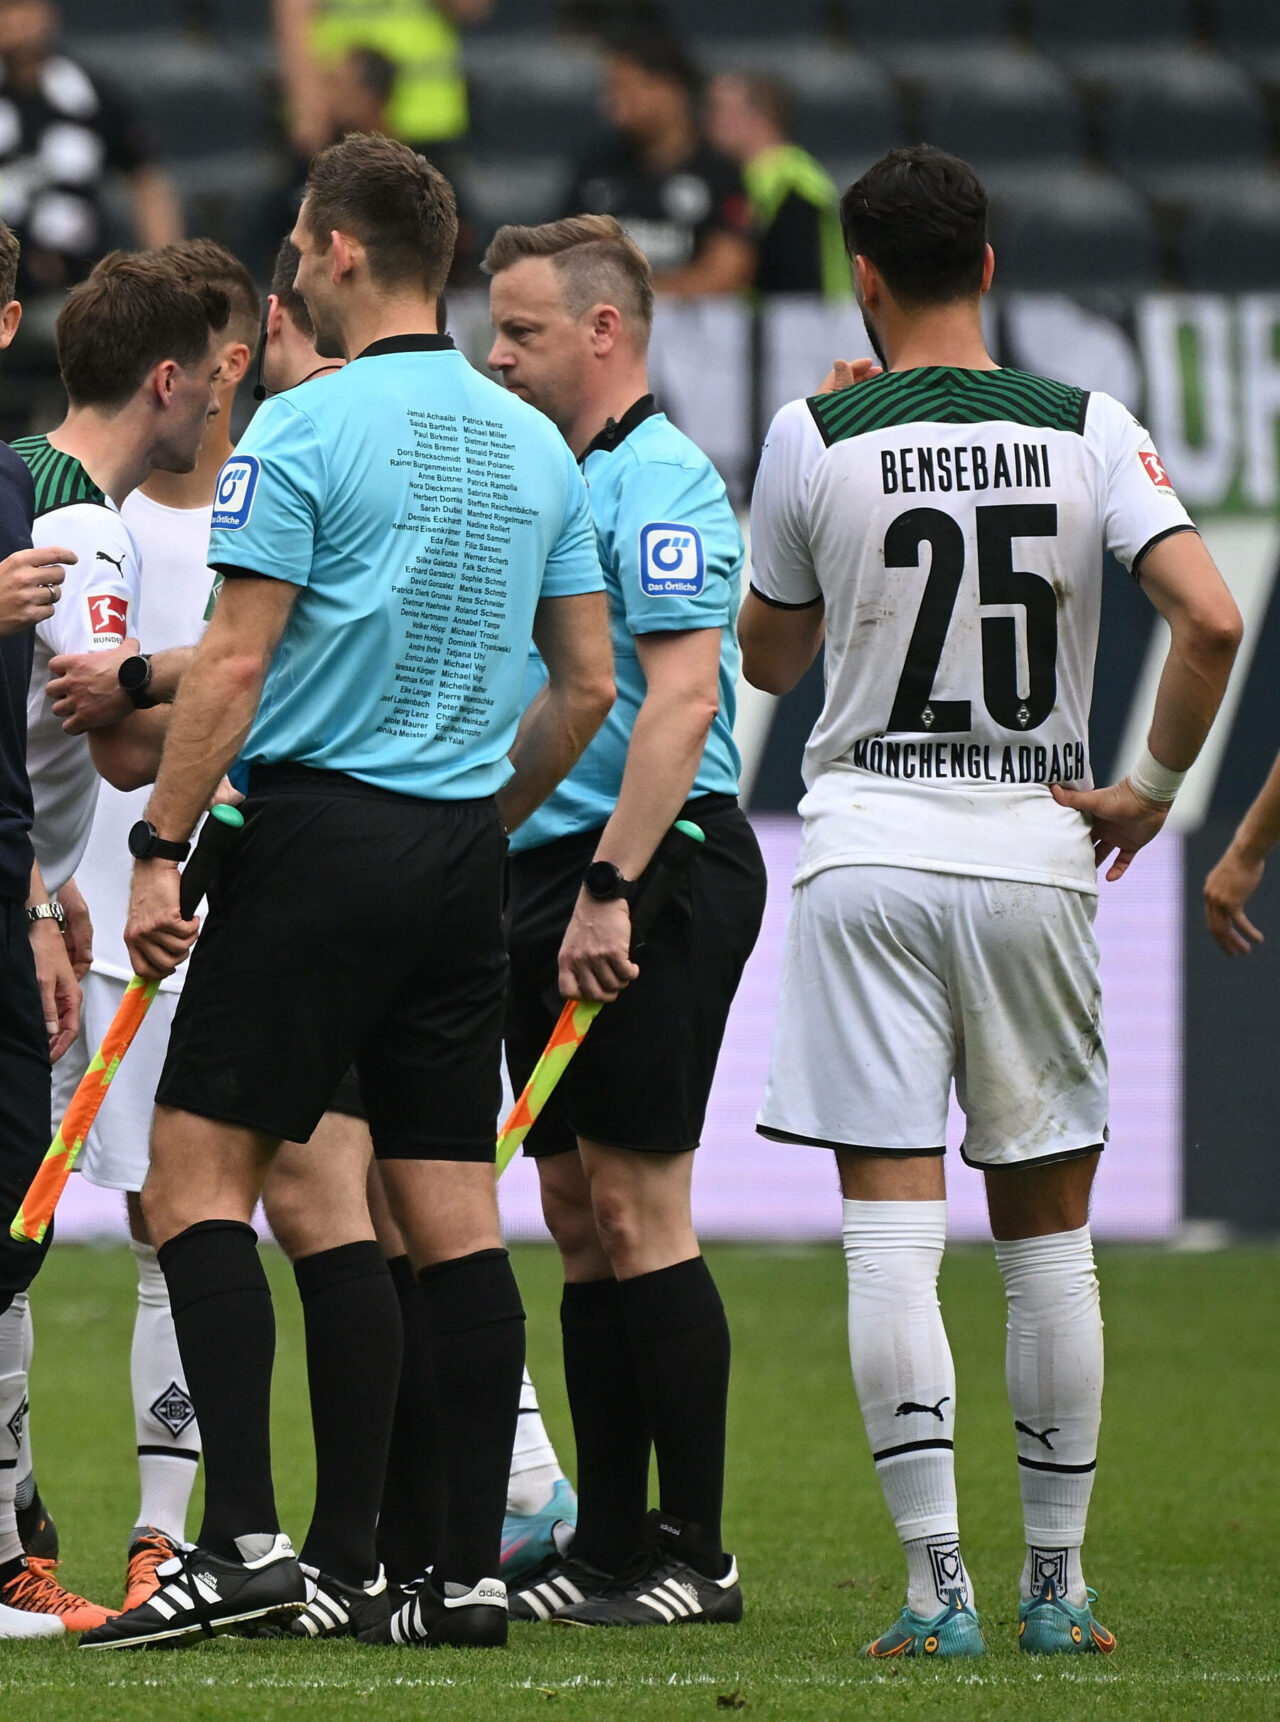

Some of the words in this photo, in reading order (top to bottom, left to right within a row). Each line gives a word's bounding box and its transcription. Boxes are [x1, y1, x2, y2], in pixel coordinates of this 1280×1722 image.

[407, 409, 425, 418] Jamal
[410, 419, 427, 428] Saida
[429, 422, 457, 432] Barthels
[462, 416, 484, 426] Patrick
[486, 420, 503, 428] Menz
[414, 430, 428, 438] Paul
[464, 426, 488, 436] Michael
[489, 430, 507, 438] Miller
[417, 440, 432, 449] Alois
[435, 443, 459, 452] Bremer
[464, 436, 488, 446] Dietmar
[490, 441, 516, 450] Neubert
[415, 450, 461, 462] Brockschmidt
[466, 447, 488, 456] Ronald
[489, 450, 510, 459] Patzer
[413, 460, 462, 472] Burgenmeister
[881, 443, 1052, 494] BENSEBAINI
[418, 472, 434, 480] Anne
[487, 470, 511, 480] Prieser
[409, 481, 423, 490] Nora
[468, 478, 488, 488] Patrick
[414, 492, 438, 502] Herbert
[468, 488, 491, 498] Sabrina
[421, 504, 440, 512] Sarah
[468, 499, 490, 508] Steffen
[491, 502, 540, 516] Reichenbächer
[408, 513, 431, 522] Dennis
[467, 509, 492, 520] Manfred
[494, 514, 532, 526] Ringelmann
[466, 520, 488, 530] Nadine
[431, 536, 443, 544] Eda
[466, 530, 484, 540] Bernd
[424, 546, 440, 554] Viola
[442, 548, 458, 557] Funke
[479, 544, 502, 553] Sassen
[464, 552, 486, 562] Werner
[406, 566, 428, 574] Erhard
[462, 562, 475, 571] Falk
[411, 577, 427, 586] David
[461, 574, 482, 584] Sophie
[392, 586, 414, 595] Patrick
[459, 584, 482, 594] Markus
[648, 583, 664, 592] Das
[664, 580, 698, 592] Örtliche
[458, 595, 472, 604] Hans
[401, 608, 420, 618] Denise
[421, 612, 448, 622] Hartmann
[456, 606, 478, 616] Roland
[453, 616, 481, 626] Annabel
[884, 503, 1058, 733] 25
[451, 627, 478, 638] Michael
[448, 638, 478, 648] Dominik
[446, 648, 472, 658] Tatjana
[444, 659, 472, 670] Michael
[442, 670, 471, 680] Michael
[440, 680, 472, 692] Michelle
[412, 687, 432, 698] Lange
[438, 691, 462, 701] Pierre
[437, 702, 458, 711] Peter
[412, 709, 429, 718] Lenz
[402, 719, 428, 728] Maurer
[399, 730, 428, 738] Meister
